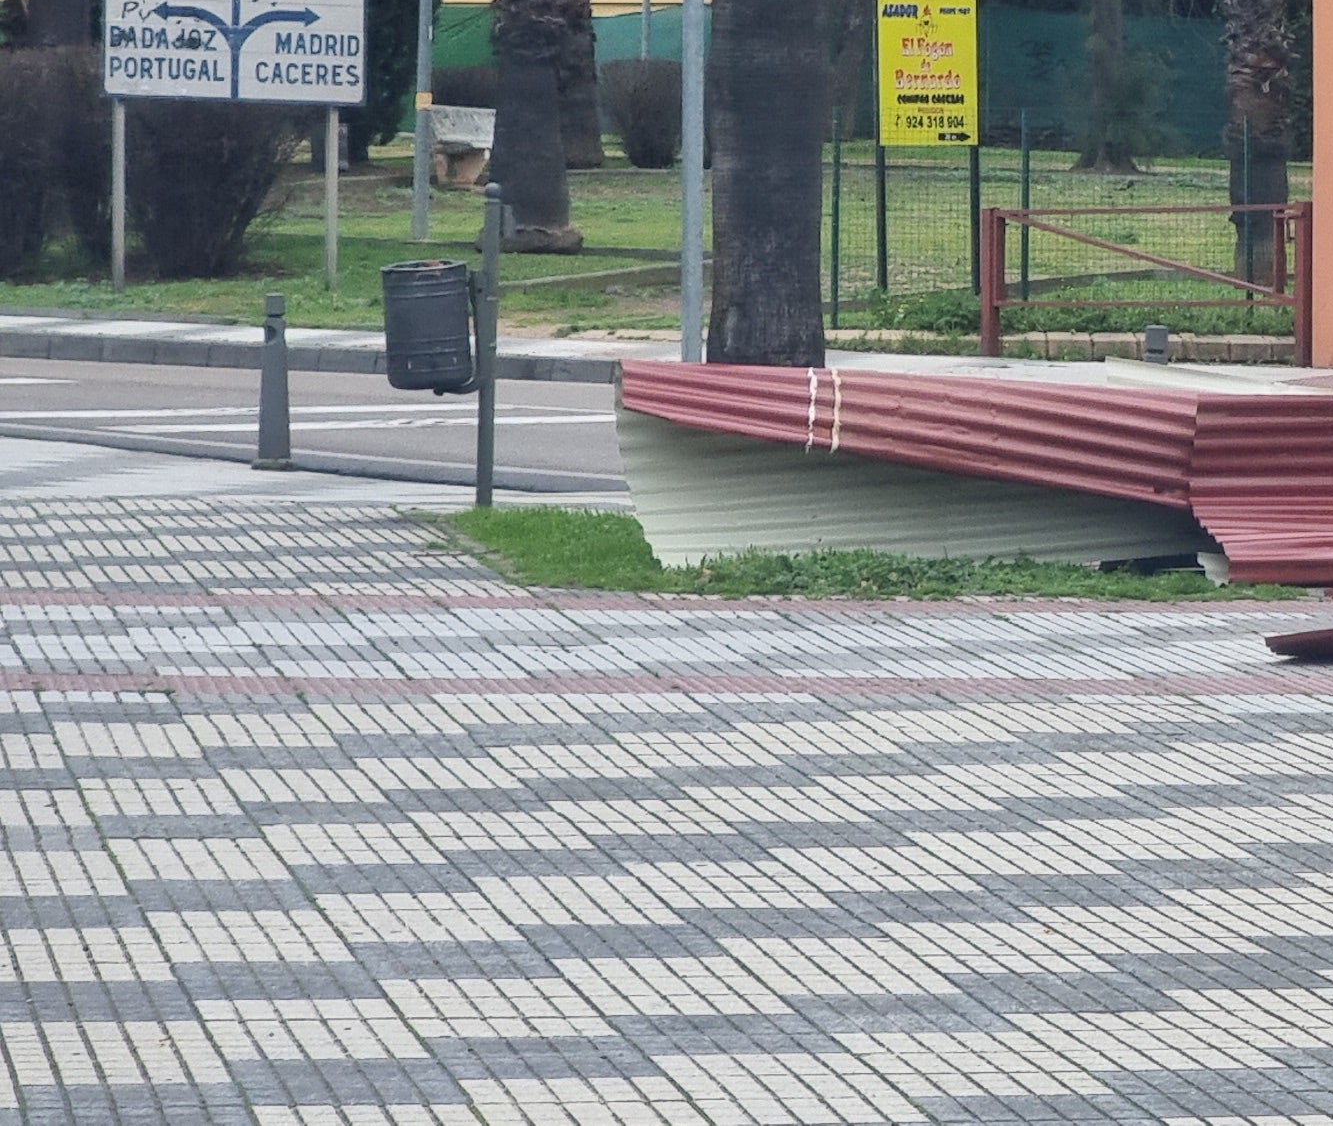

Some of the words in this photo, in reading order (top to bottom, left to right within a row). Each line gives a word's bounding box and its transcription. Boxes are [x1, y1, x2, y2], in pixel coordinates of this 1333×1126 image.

[275, 32, 360, 57] MADRID
[902, 37, 914, 56] El
[109, 55, 226, 82] PORTUGAL
[255, 61, 360, 87] CACERES
[895, 69, 961, 90] Bernardo
[906, 116, 923, 128] 924
[926, 116, 944, 128] 318
